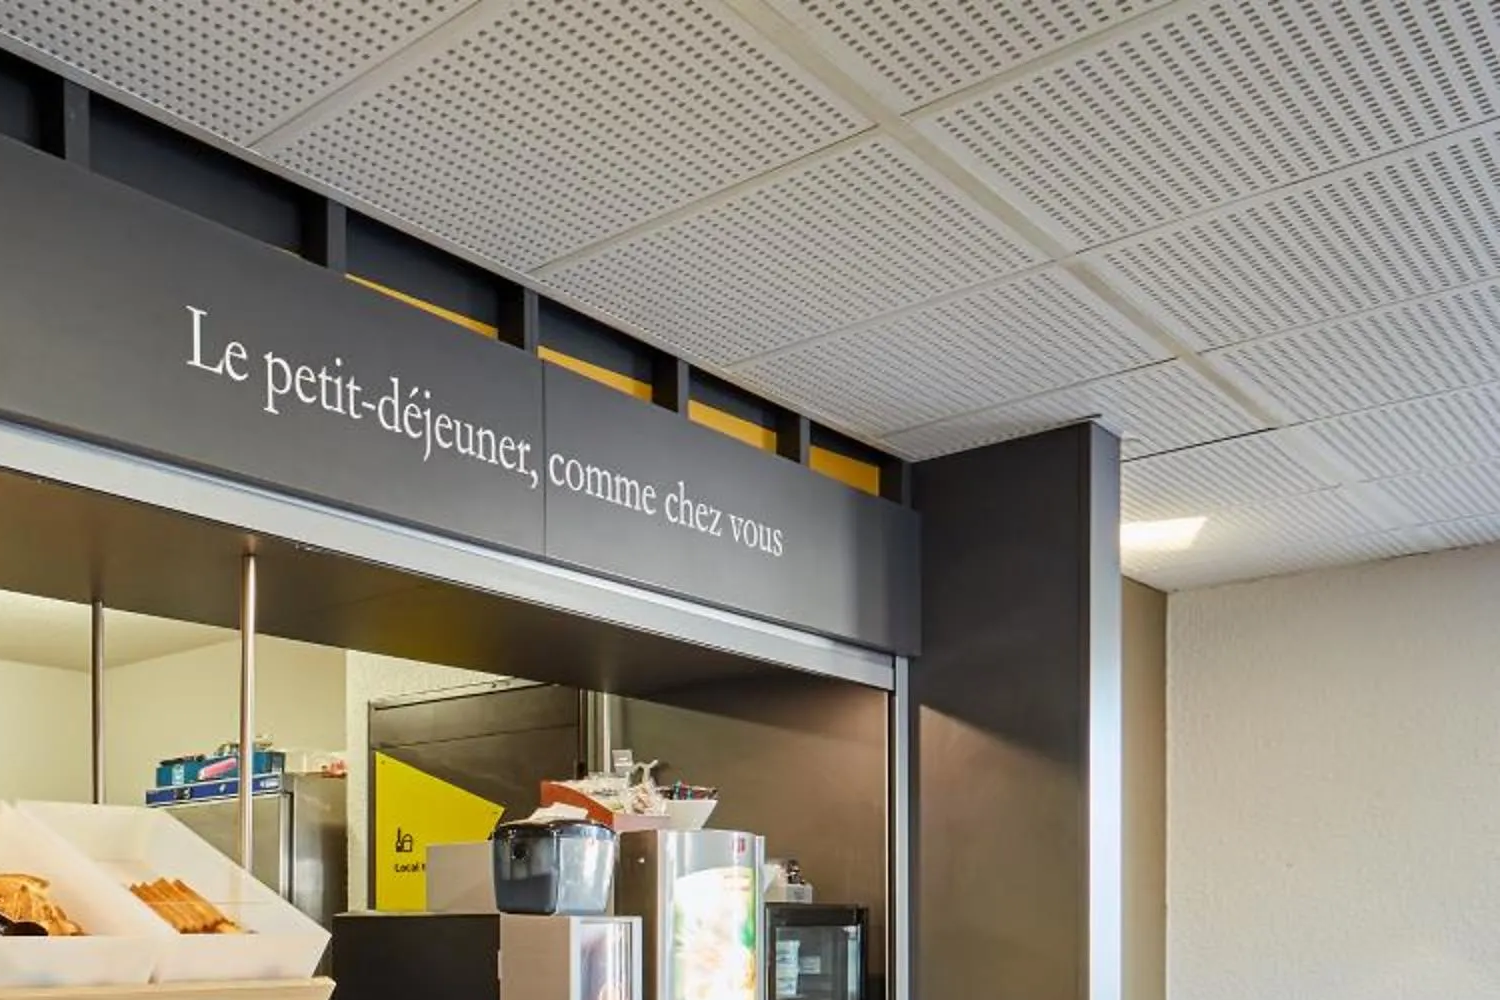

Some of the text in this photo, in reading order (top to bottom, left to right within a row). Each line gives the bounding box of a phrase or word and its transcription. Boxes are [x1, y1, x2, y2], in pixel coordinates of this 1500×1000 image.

[185, 304, 785, 557] Le petit-déjeuner, comme chez vous
[395, 862, 419, 873] Local
